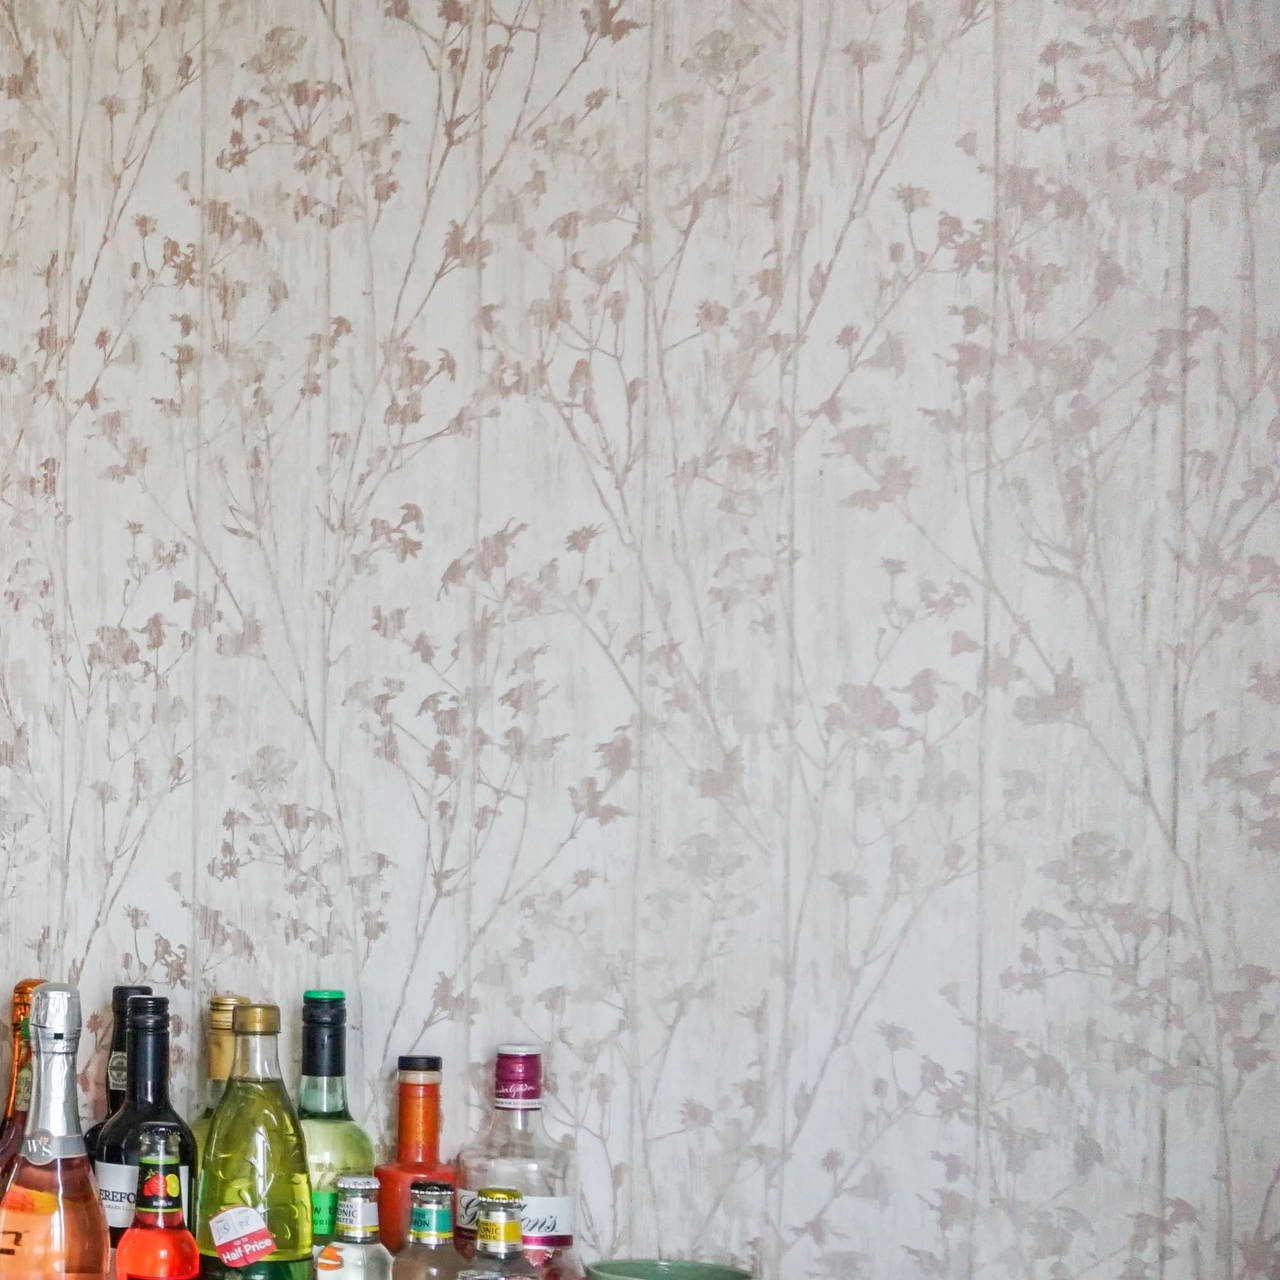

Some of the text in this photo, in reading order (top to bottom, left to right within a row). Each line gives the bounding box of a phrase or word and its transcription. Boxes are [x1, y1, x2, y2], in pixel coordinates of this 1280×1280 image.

[337, 1208, 358, 1218] ONIC
[221, 1237, 273, 1264] Half Price
